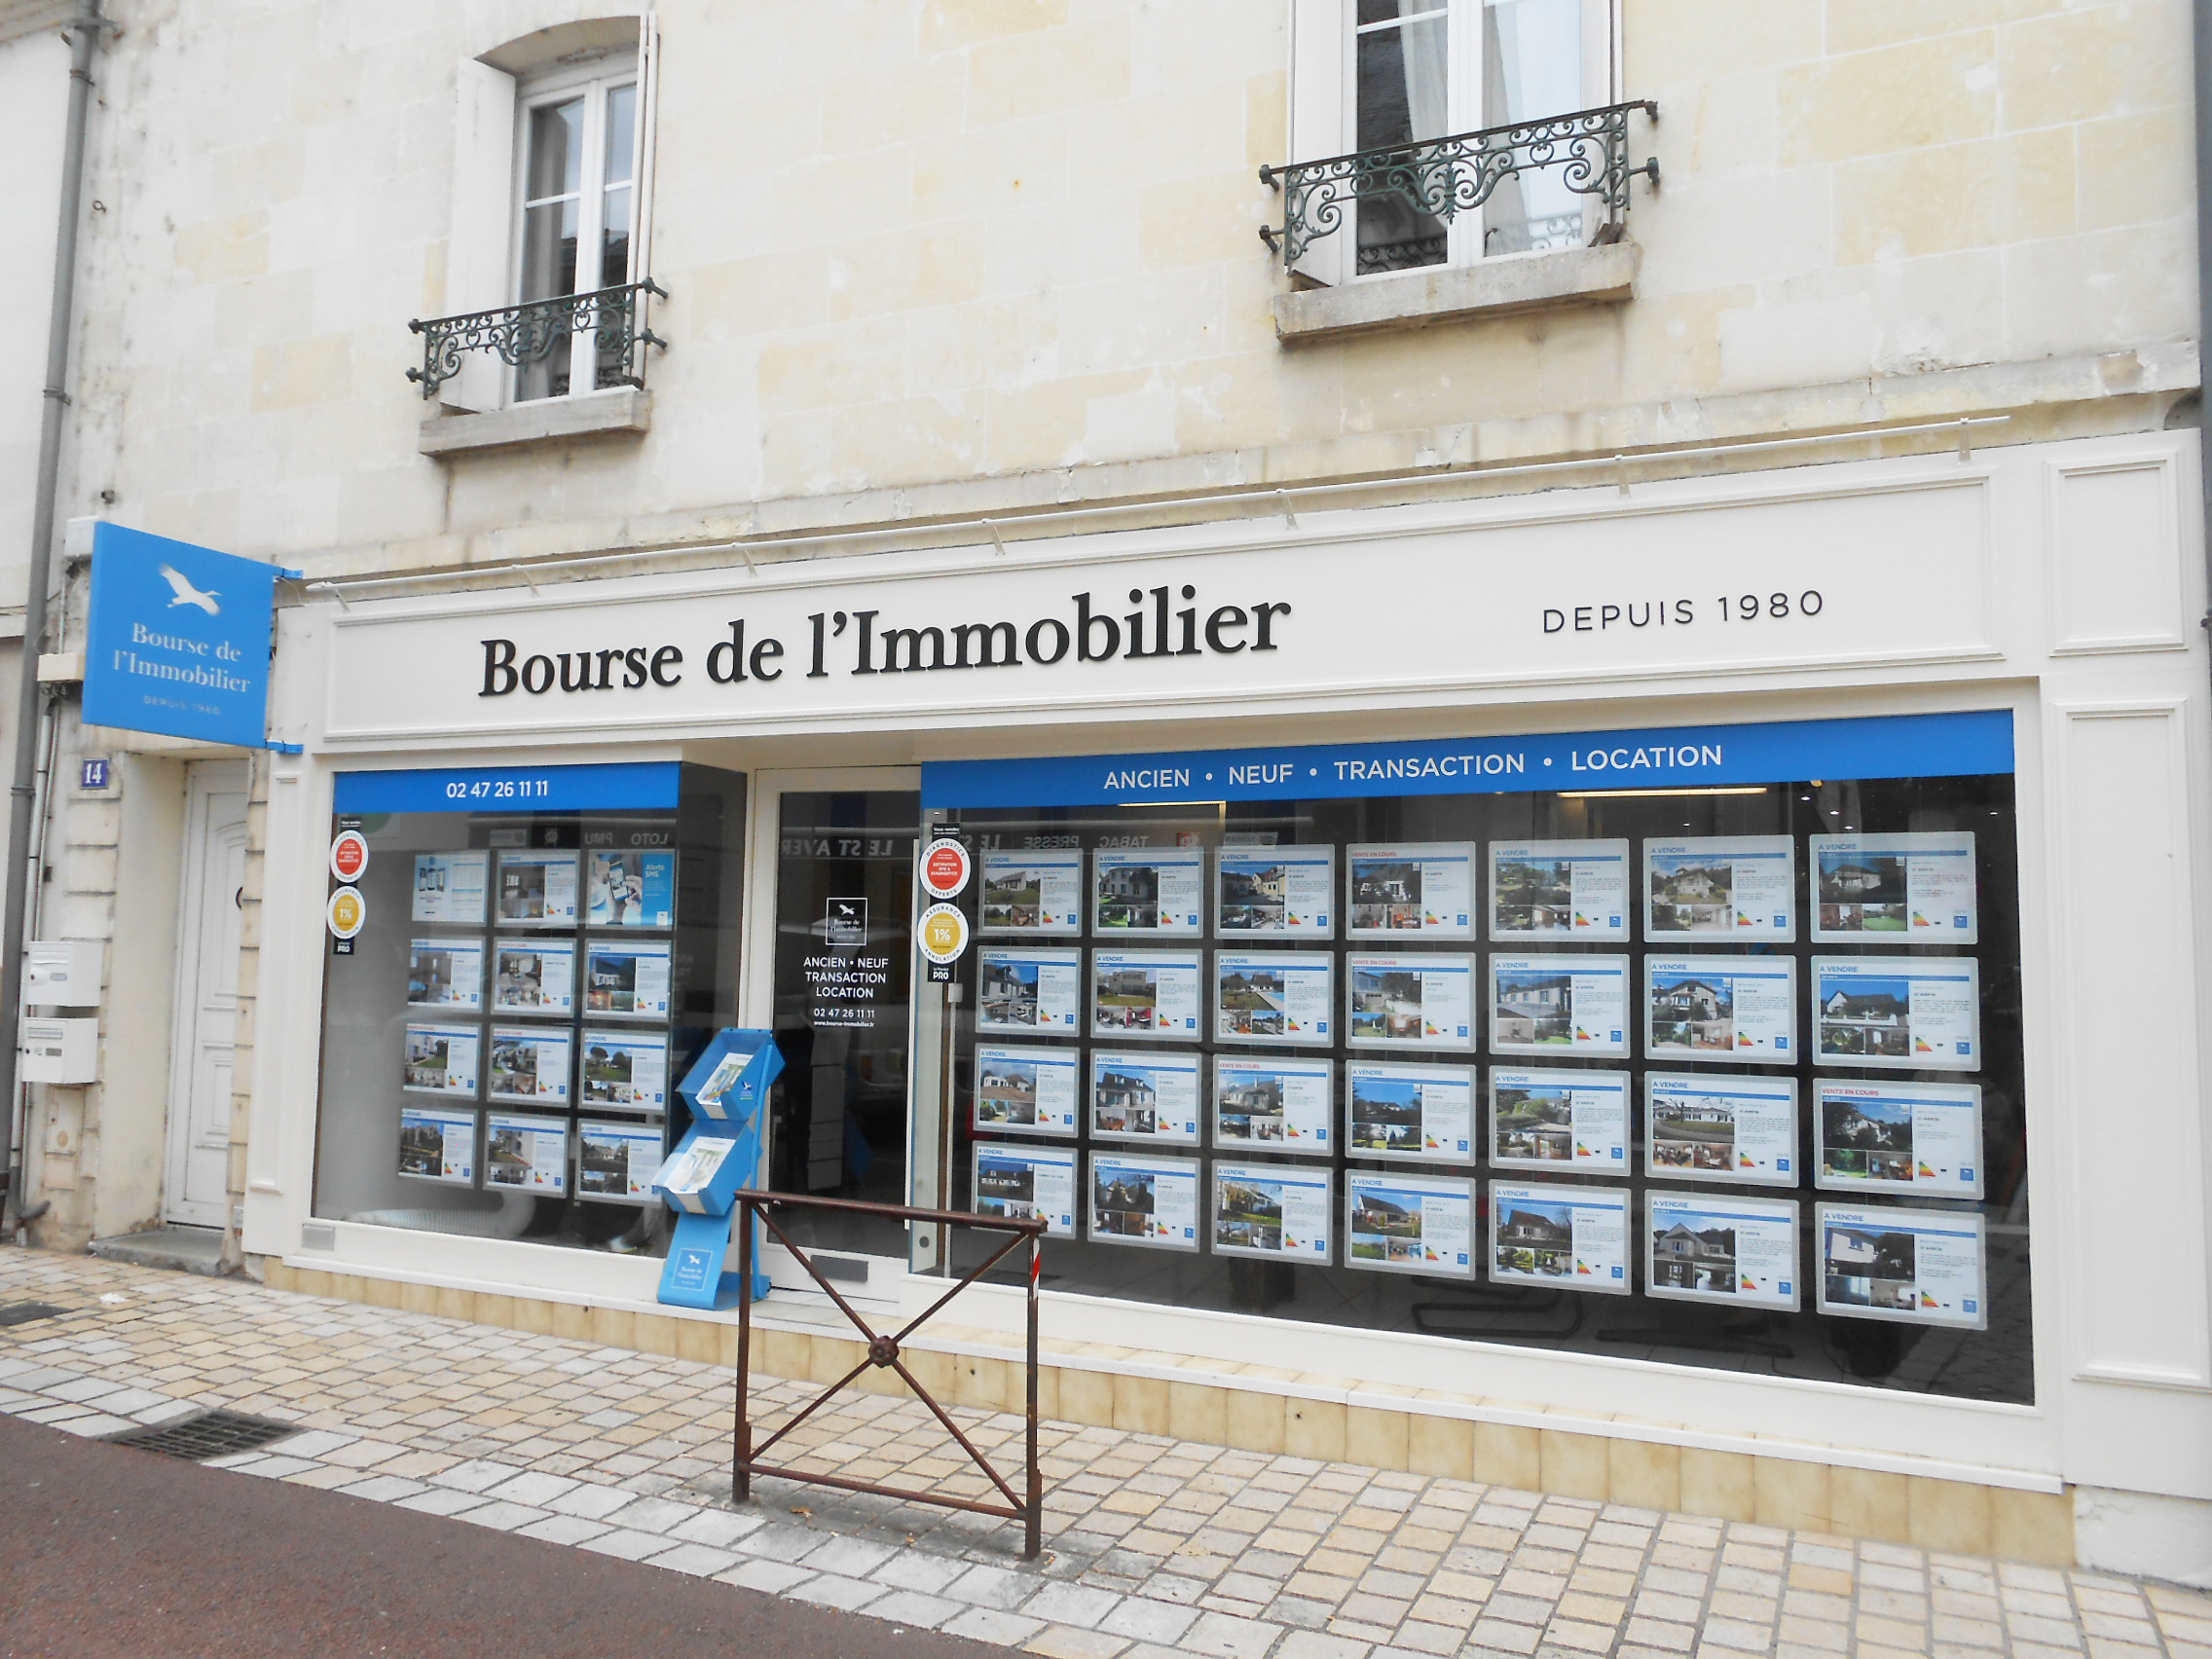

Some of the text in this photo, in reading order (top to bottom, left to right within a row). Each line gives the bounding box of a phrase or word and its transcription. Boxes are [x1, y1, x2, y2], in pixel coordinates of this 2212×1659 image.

[1543, 590, 1823, 633] DEPUIS 1980
[132, 622, 241, 662] Bourse de
[478, 584, 1292, 697] Bourse de l'Immobilier
[114, 649, 251, 692] l'Immobilier
[143, 695, 221, 716] DEPUIS 1980
[86, 762, 102, 784] 14
[1104, 745, 1721, 790] ANCIEN NEUF TRANSACTION LOCATION
[447, 780, 548, 798] 02 47 26 11 11
[926, 841, 965, 857] DIAGNOSTICS
[931, 888, 958, 897] OFFERTS
[926, 905, 961, 918] ASSURANCE
[935, 928, 950, 940] 1%
[803, 956, 889, 969] ANCIEN NEUF
[924, 948, 961, 962] ANNULATION
[805, 971, 886, 983] TRANSACTION
[933, 972, 949, 980] PRO
[816, 986, 874, 998] LOCATION
[813, 1008, 875, 1018] 02 47 26 11 11
